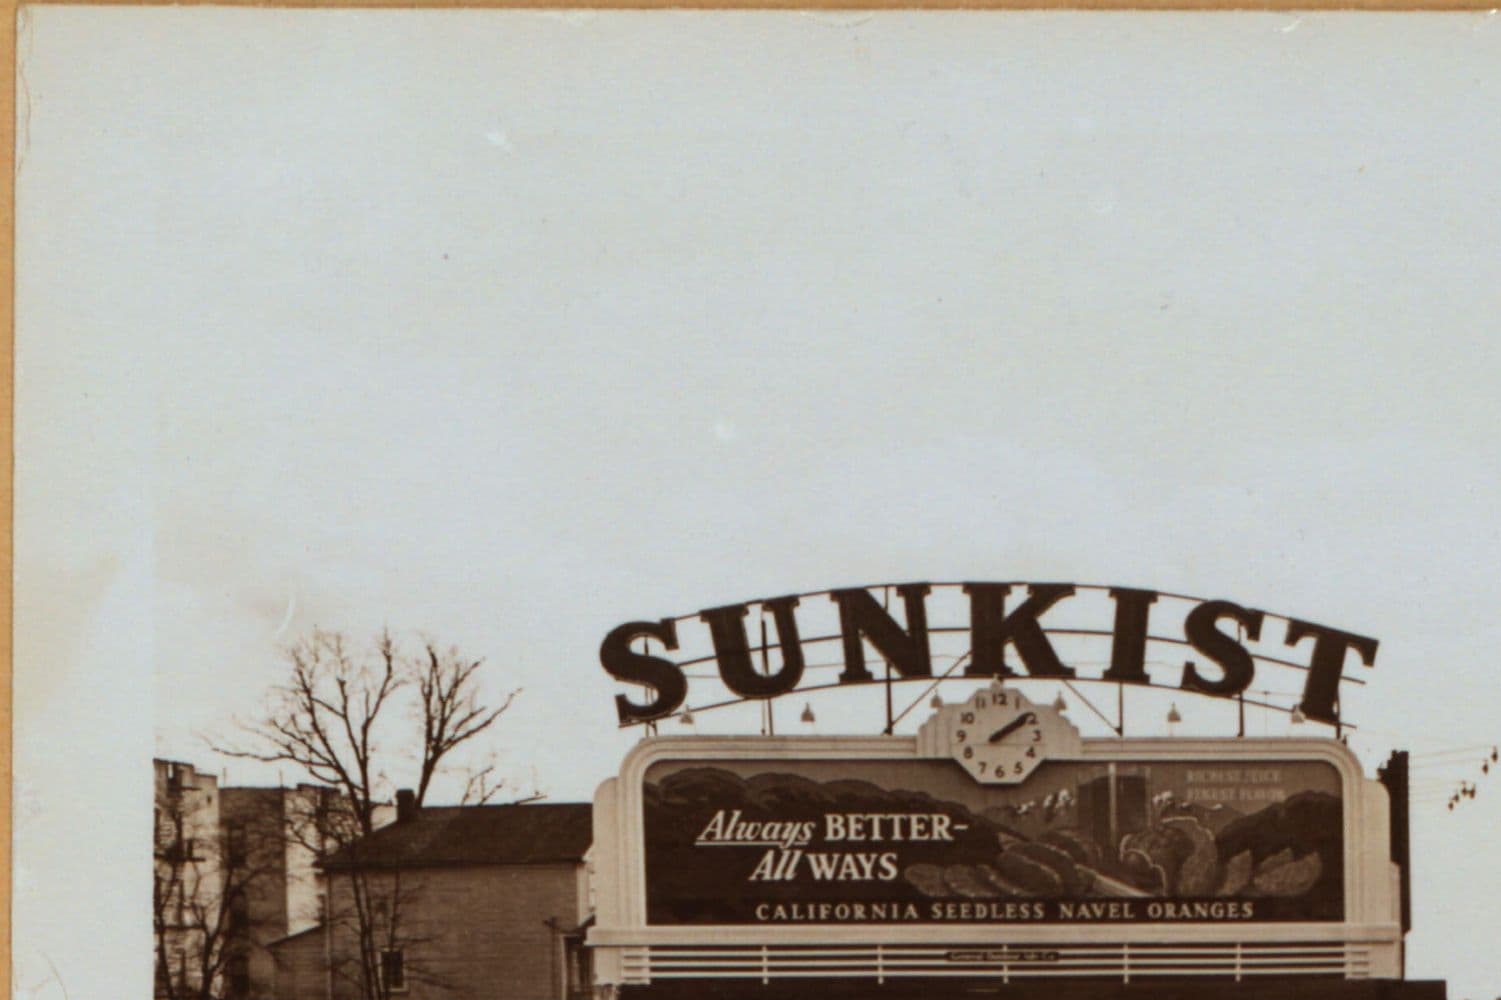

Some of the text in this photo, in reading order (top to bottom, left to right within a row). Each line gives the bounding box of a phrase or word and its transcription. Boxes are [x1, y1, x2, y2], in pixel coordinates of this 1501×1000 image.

[599, 583, 1379, 725] SUNKIST
[992, 693, 1007, 706] 12
[961, 712, 974, 724] 10
[957, 729, 966, 743] 9
[1033, 729, 1042, 742] 3
[963, 746, 974, 759] 8
[1025, 746, 1035, 758] 4
[978, 761, 988, 774] 7
[995, 765, 1005, 778] 6
[1014, 761, 1024, 774] 5
[696, 810, 817, 849] Always
[748, 849, 898, 881] All WAYS
[755, 902, 1254, 920] CALIFORNIA SEEDLESS NAVEL ORANGES
